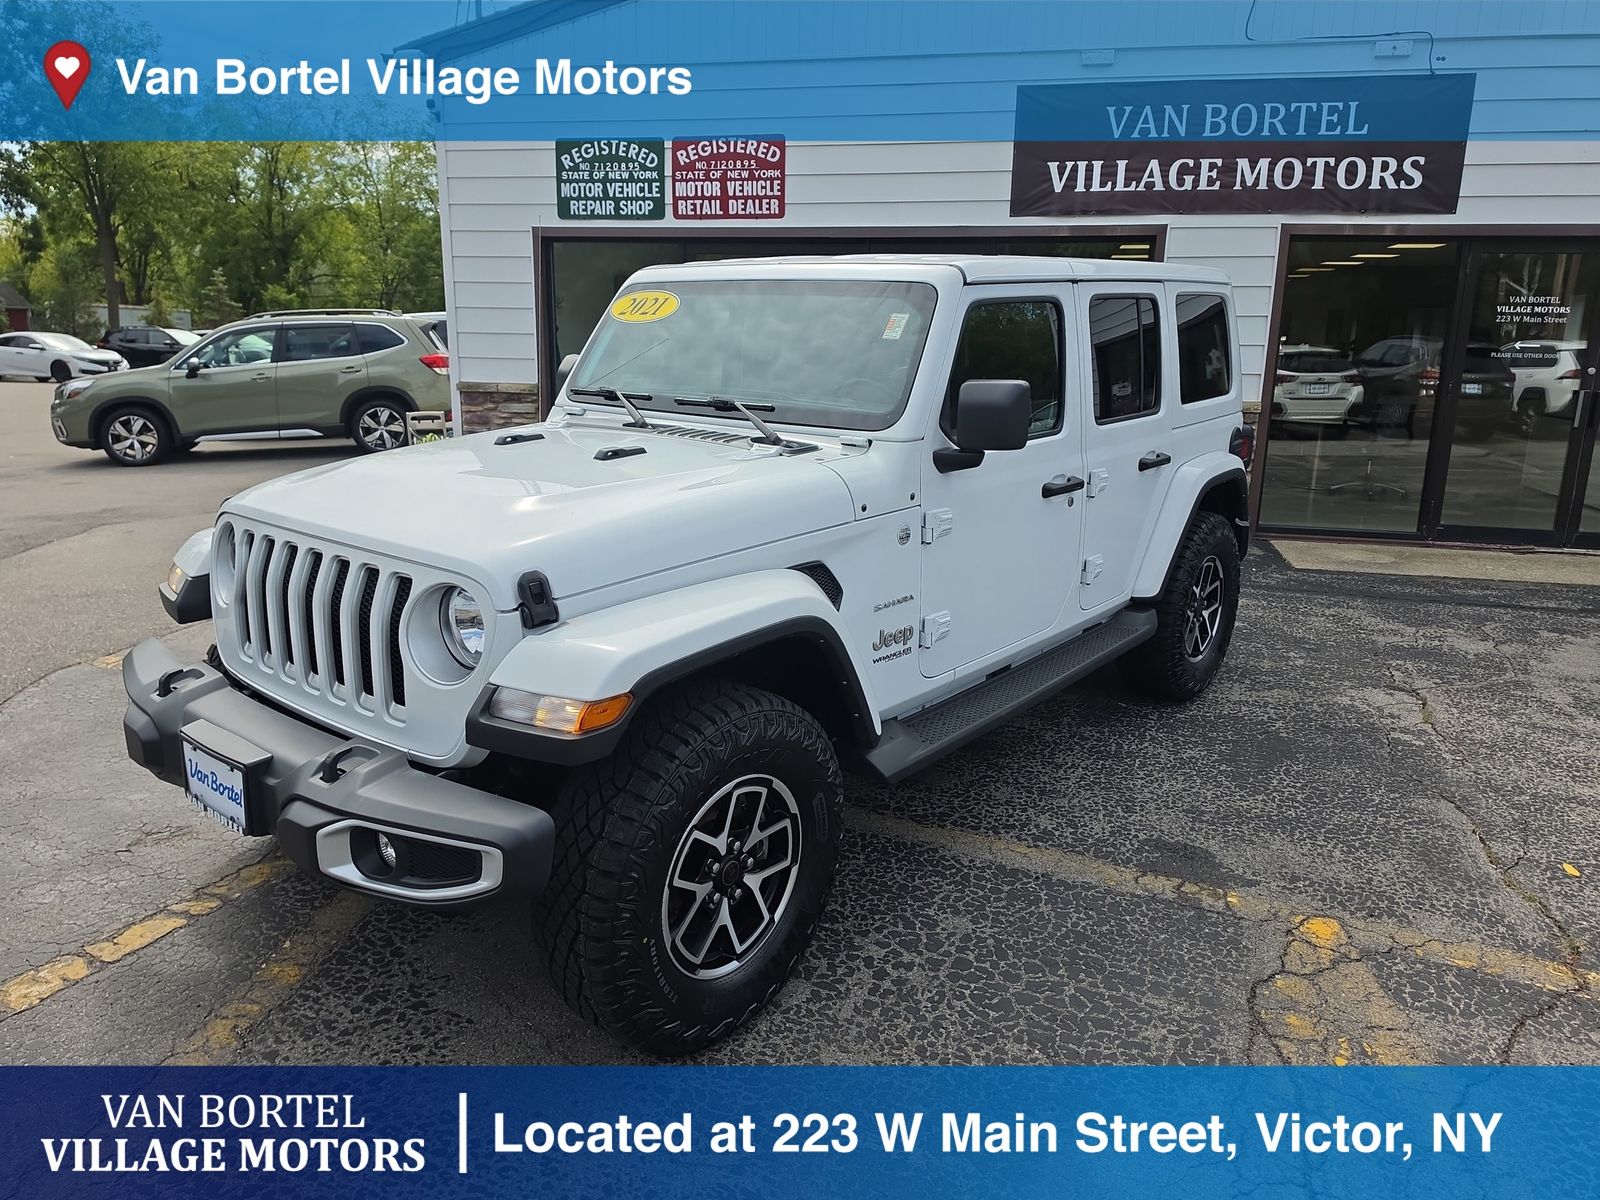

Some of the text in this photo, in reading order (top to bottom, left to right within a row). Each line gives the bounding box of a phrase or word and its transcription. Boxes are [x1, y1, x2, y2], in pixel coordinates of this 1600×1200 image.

[1106, 101, 1369, 139] VAN BORTEL
[560, 140, 659, 169] REGISTERED
[676, 137, 781, 165] REGISTERED
[593, 162, 640, 171] 7120895
[709, 159, 757, 169] 7120895
[561, 171, 659, 180] STATE OF NEW YORK
[675, 169, 782, 180] STATE OF NEW YORK
[1047, 156, 1426, 193] VILLAGE MOTORS
[560, 182, 661, 198] MOTOR VEHICLE
[675, 180, 782, 197] MOTOR VEHICLE
[570, 200, 654, 215] REPAIR SHOP
[677, 198, 779, 215] RETAIL DEALER
[616, 296, 670, 316] 2021
[1509, 295, 1561, 304] VAN BORTEL
[1496, 305, 1571, 314] VILLAGE MOTORS
[1495, 315, 1567, 324] 223 W Main Street
[872, 624, 914, 651] Jeep
[649, 938, 678, 1004] TERRITORY
